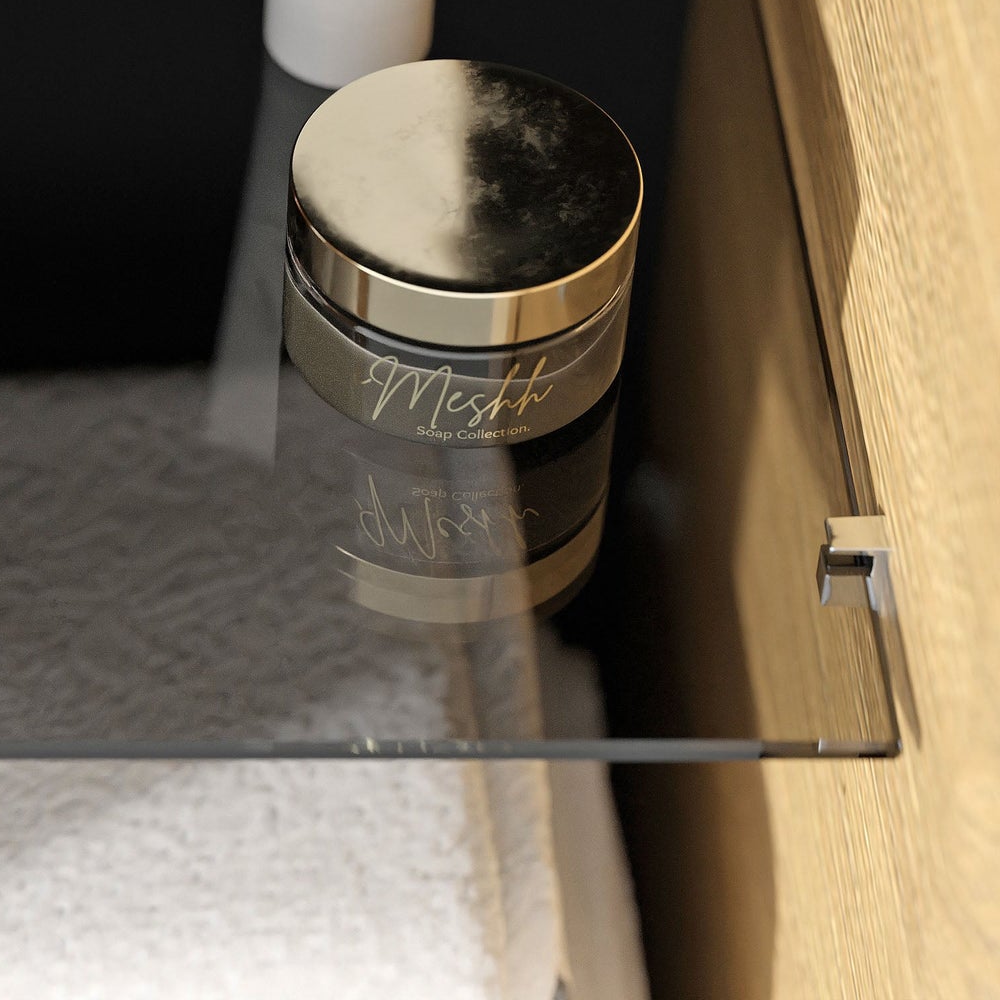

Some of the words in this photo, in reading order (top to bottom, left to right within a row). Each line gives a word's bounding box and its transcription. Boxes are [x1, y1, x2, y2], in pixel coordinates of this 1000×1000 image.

[360, 354, 554, 429] Meshh
[416, 425, 453, 442] Soap
[456, 425, 531, 441] Collection.
